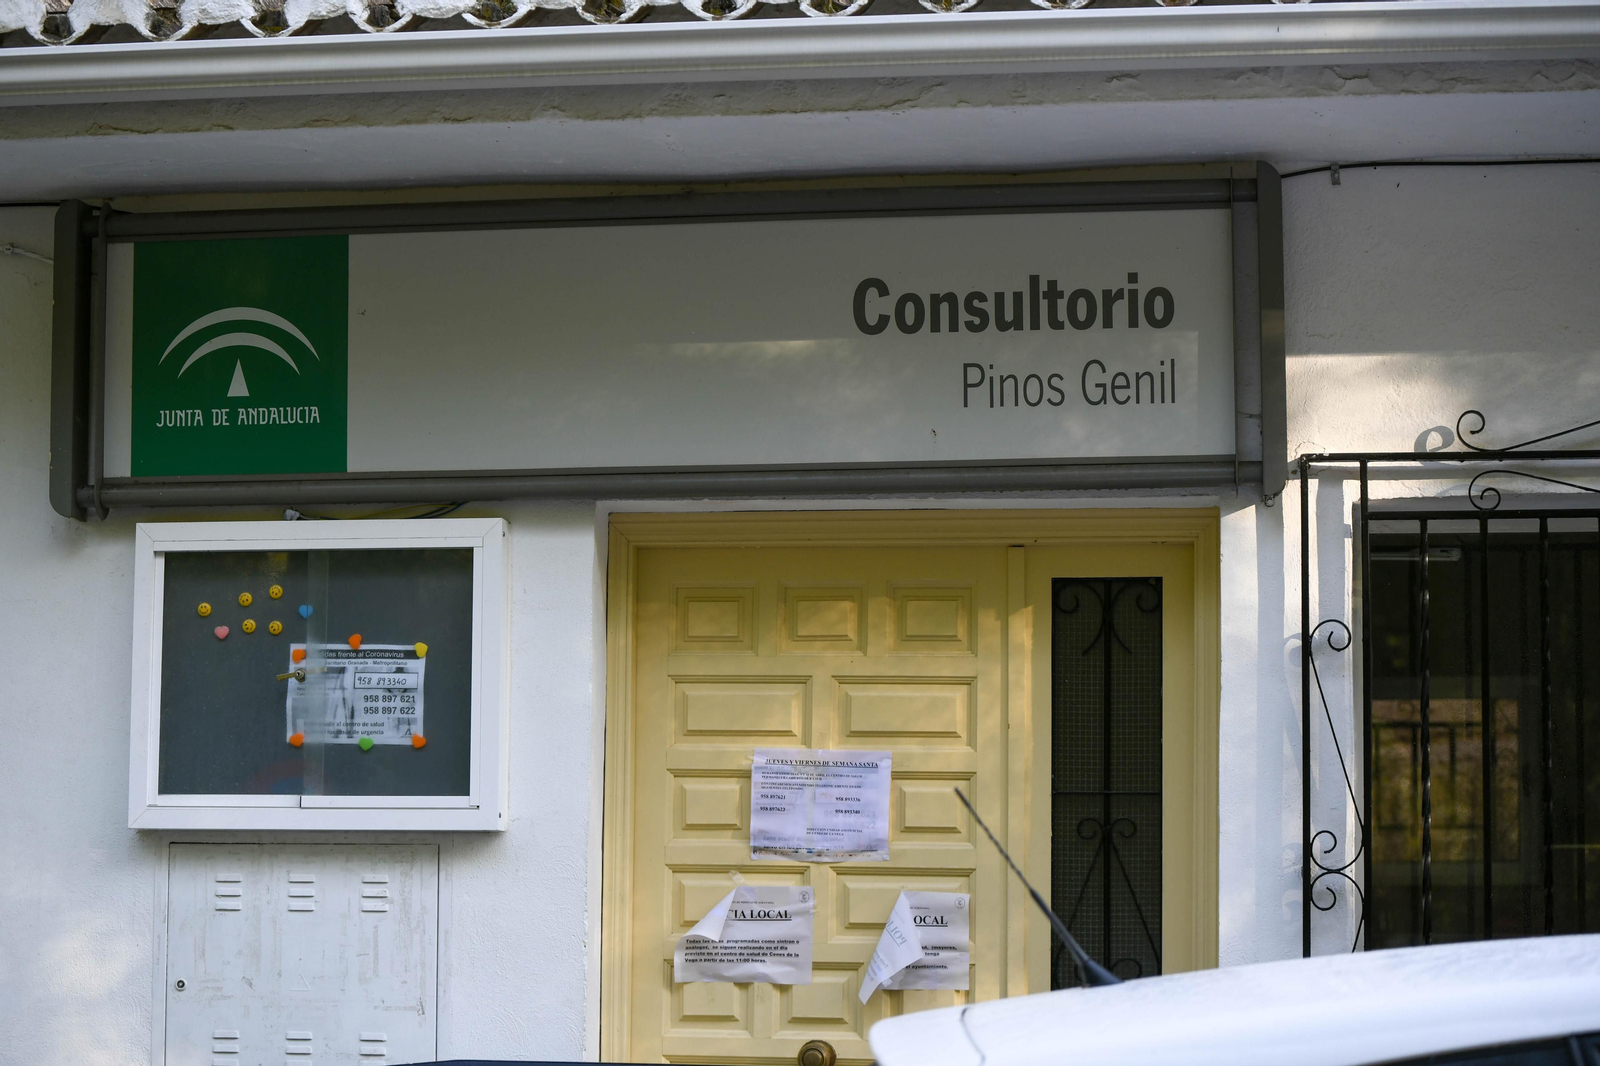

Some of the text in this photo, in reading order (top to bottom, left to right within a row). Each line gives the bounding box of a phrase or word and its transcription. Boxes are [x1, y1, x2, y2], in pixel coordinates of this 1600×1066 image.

[852, 271, 1175, 335] Consultorio
[963, 358, 1176, 409] Pinos Genil
[156, 406, 321, 428] JUNTA DE ANDALUCIA
[357, 676, 407, 686] 958 893340
[363, 695, 416, 703] 958 897 621
[363, 706, 416, 715] 958 897 622
[750, 910, 792, 919] LOCAL
[914, 915, 948, 925] OCAL
